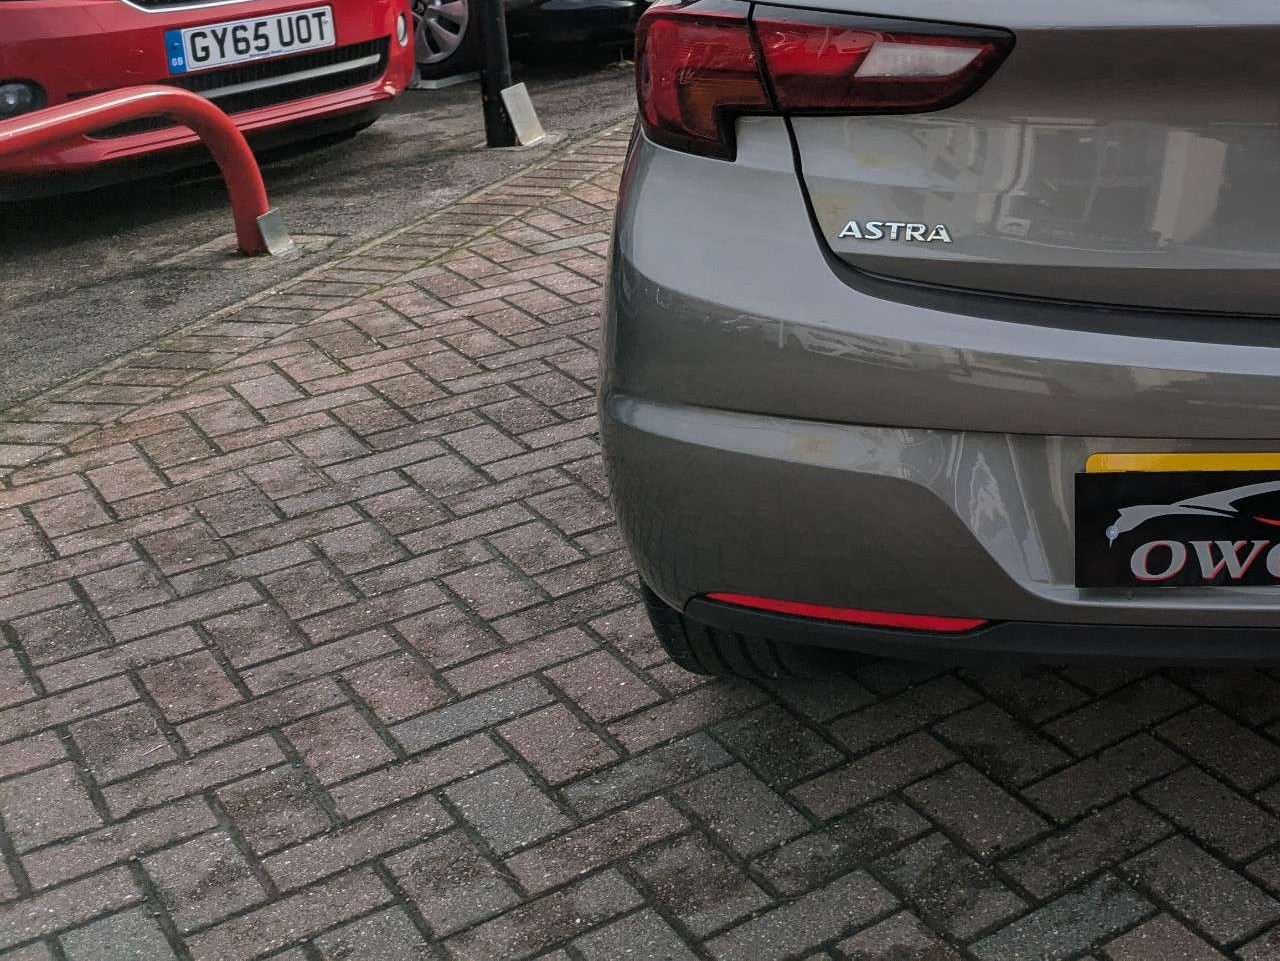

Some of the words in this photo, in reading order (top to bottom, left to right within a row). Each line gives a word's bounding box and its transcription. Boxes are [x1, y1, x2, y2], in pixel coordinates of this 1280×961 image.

[190, 21, 270, 63] GY65
[276, 11, 327, 48] UOT
[838, 220, 953, 243] ASTRA
